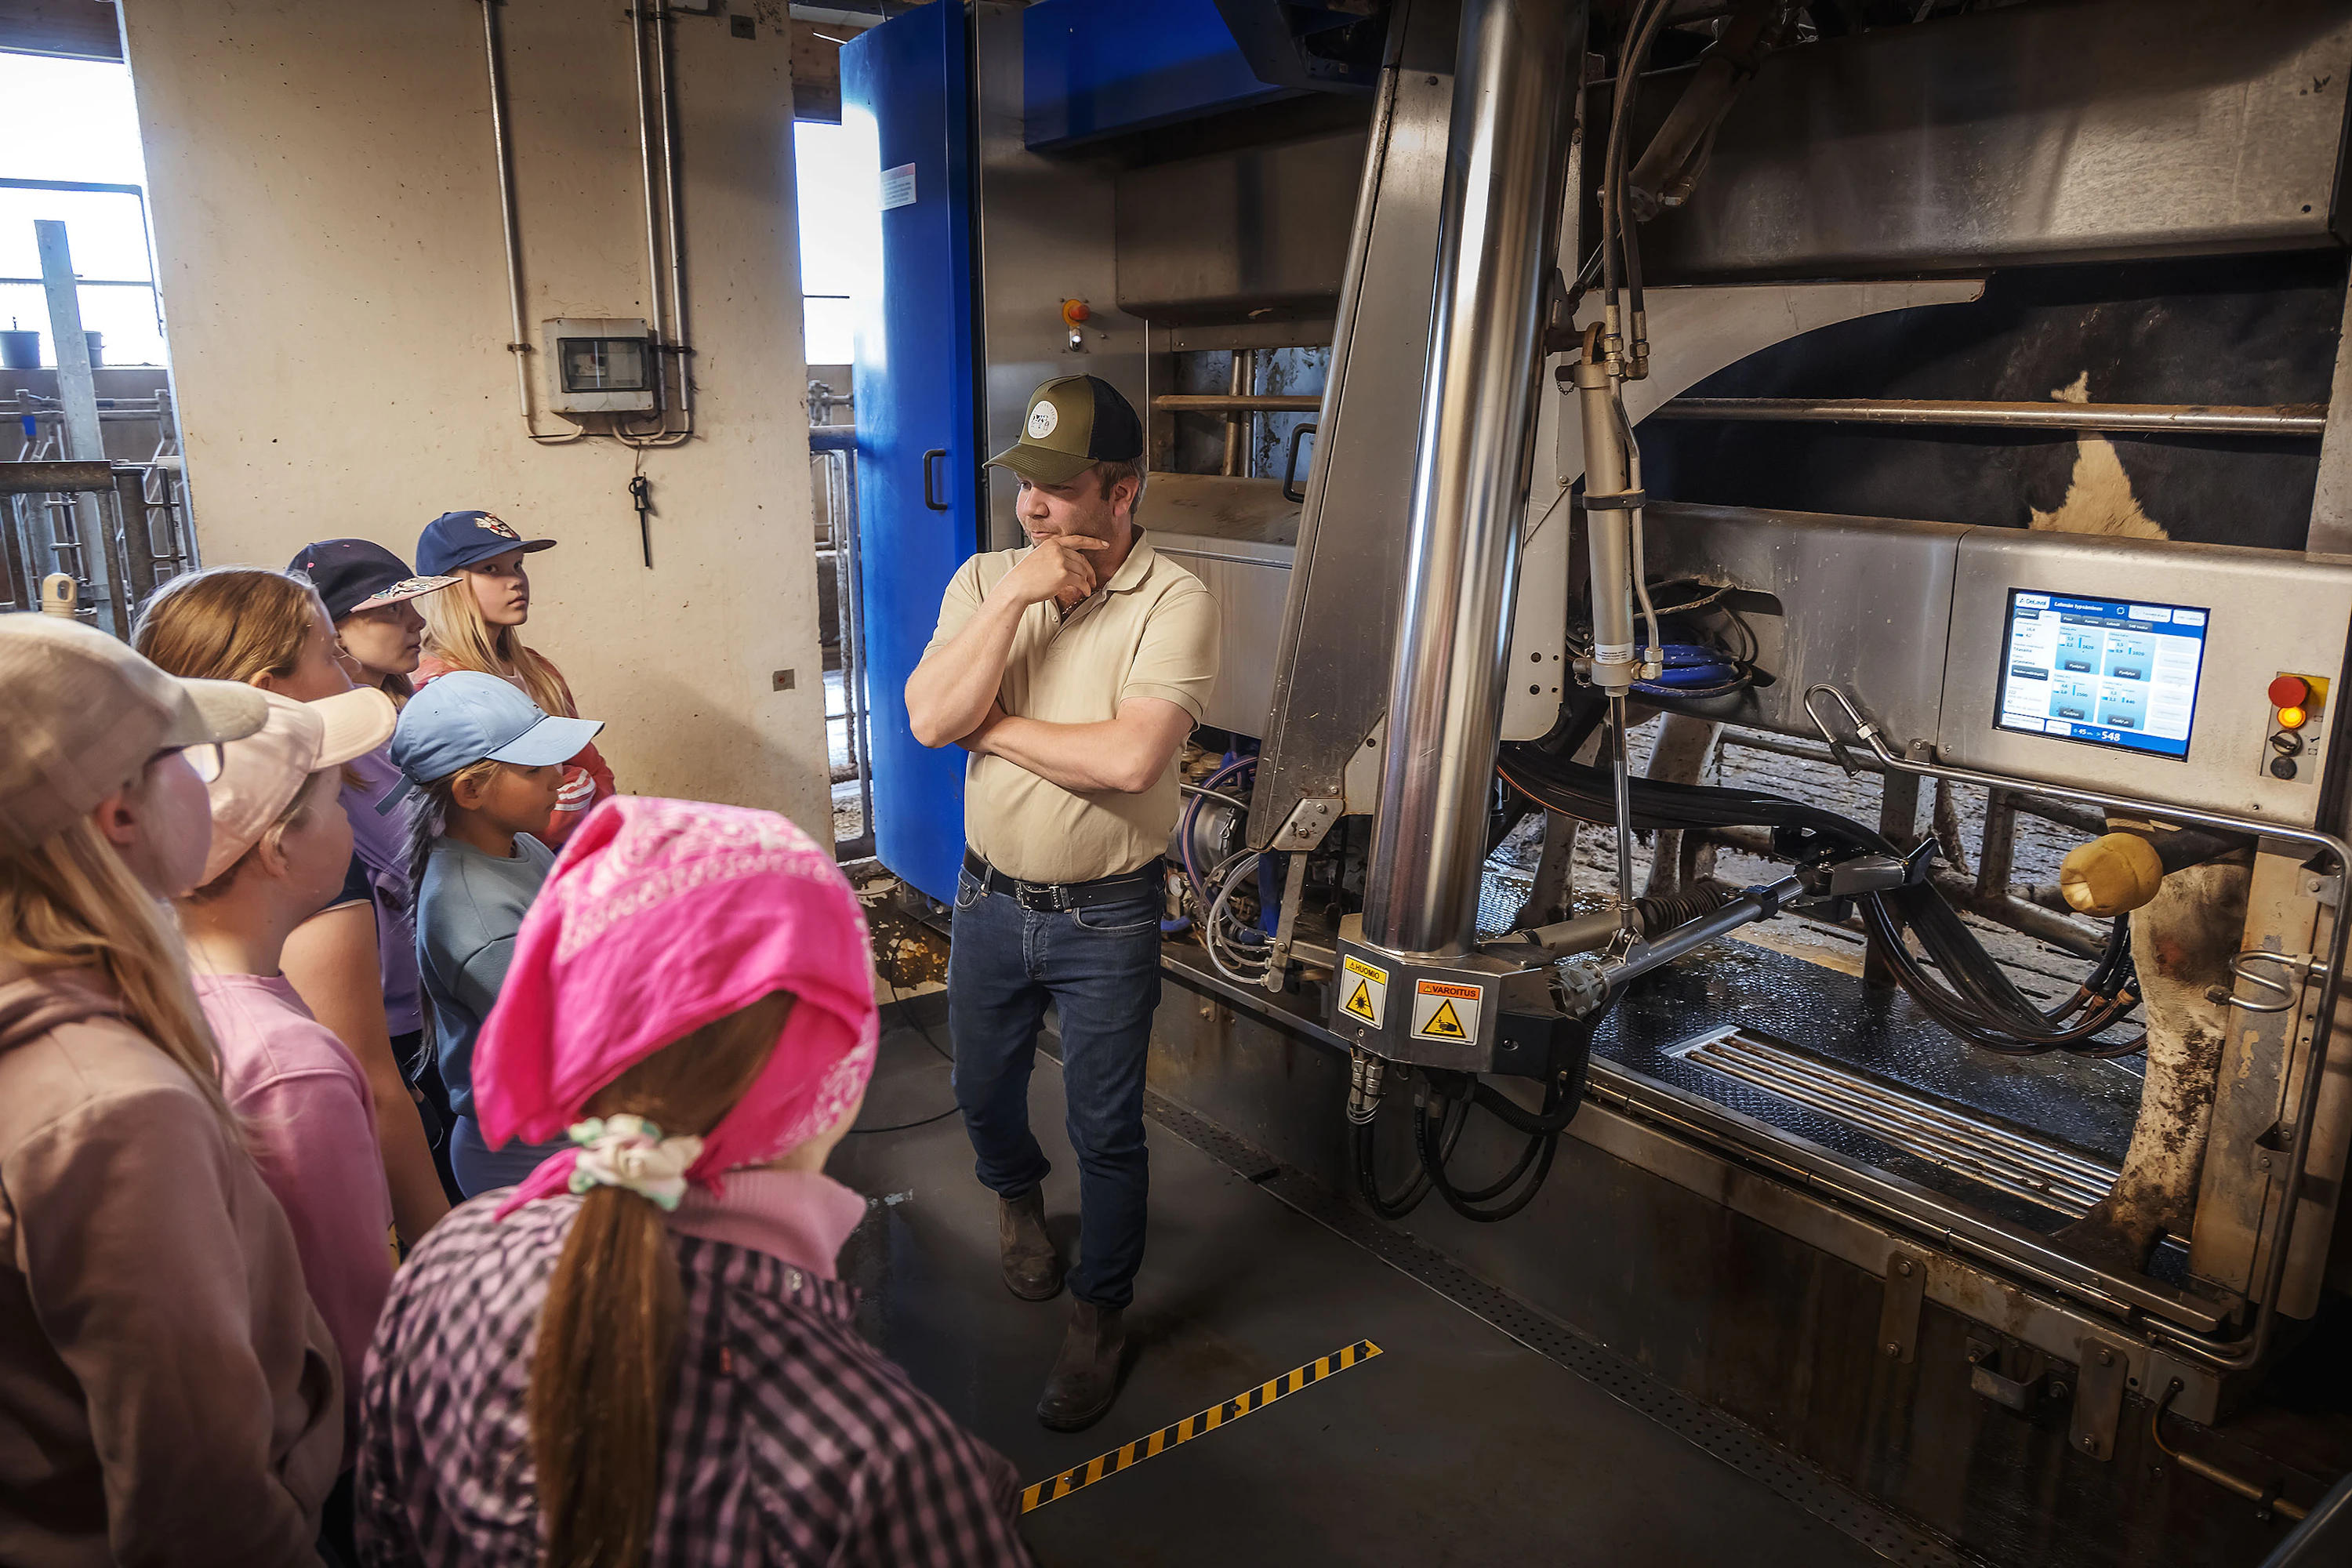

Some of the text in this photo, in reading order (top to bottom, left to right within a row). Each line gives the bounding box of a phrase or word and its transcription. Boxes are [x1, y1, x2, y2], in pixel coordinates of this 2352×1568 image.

[2101, 731, 2121, 742] 548
[1356, 964, 1380, 979] HUOMIO
[1432, 985, 1476, 997] VAROITUS
